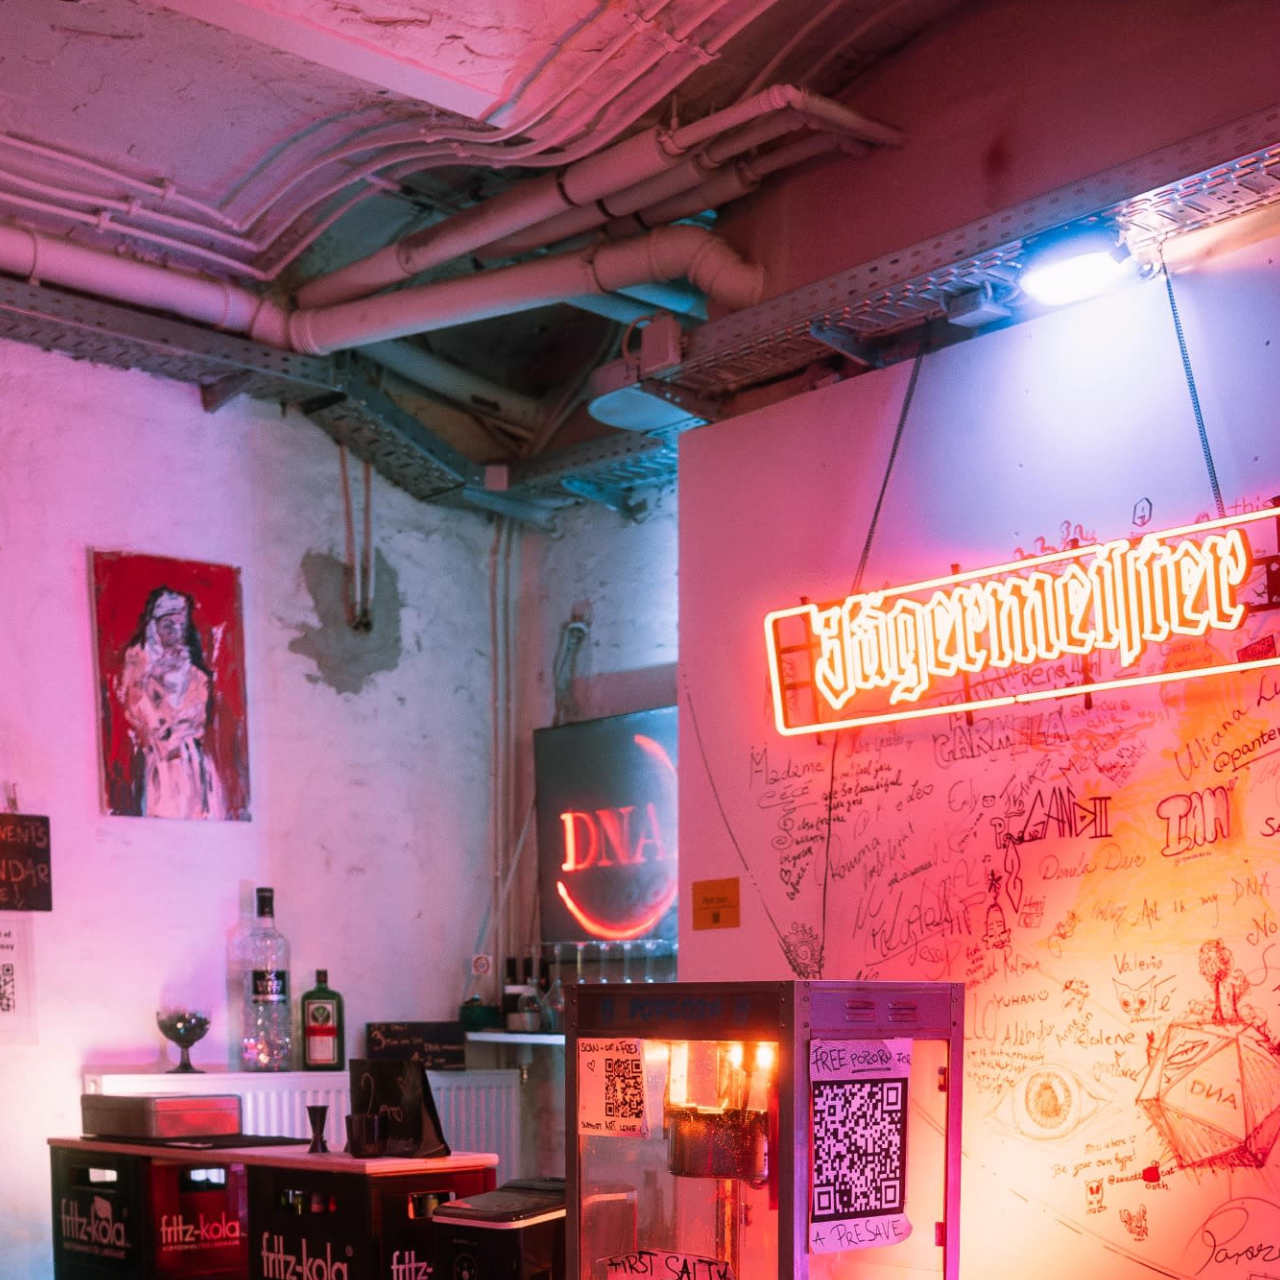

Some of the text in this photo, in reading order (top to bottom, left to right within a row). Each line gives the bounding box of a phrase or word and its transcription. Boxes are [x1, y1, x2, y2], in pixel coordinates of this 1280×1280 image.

[560, 802, 666, 873] DNA
[160, 1211, 241, 1245] fritz-kola
[830, 1219, 905, 1248] PRESAVE
